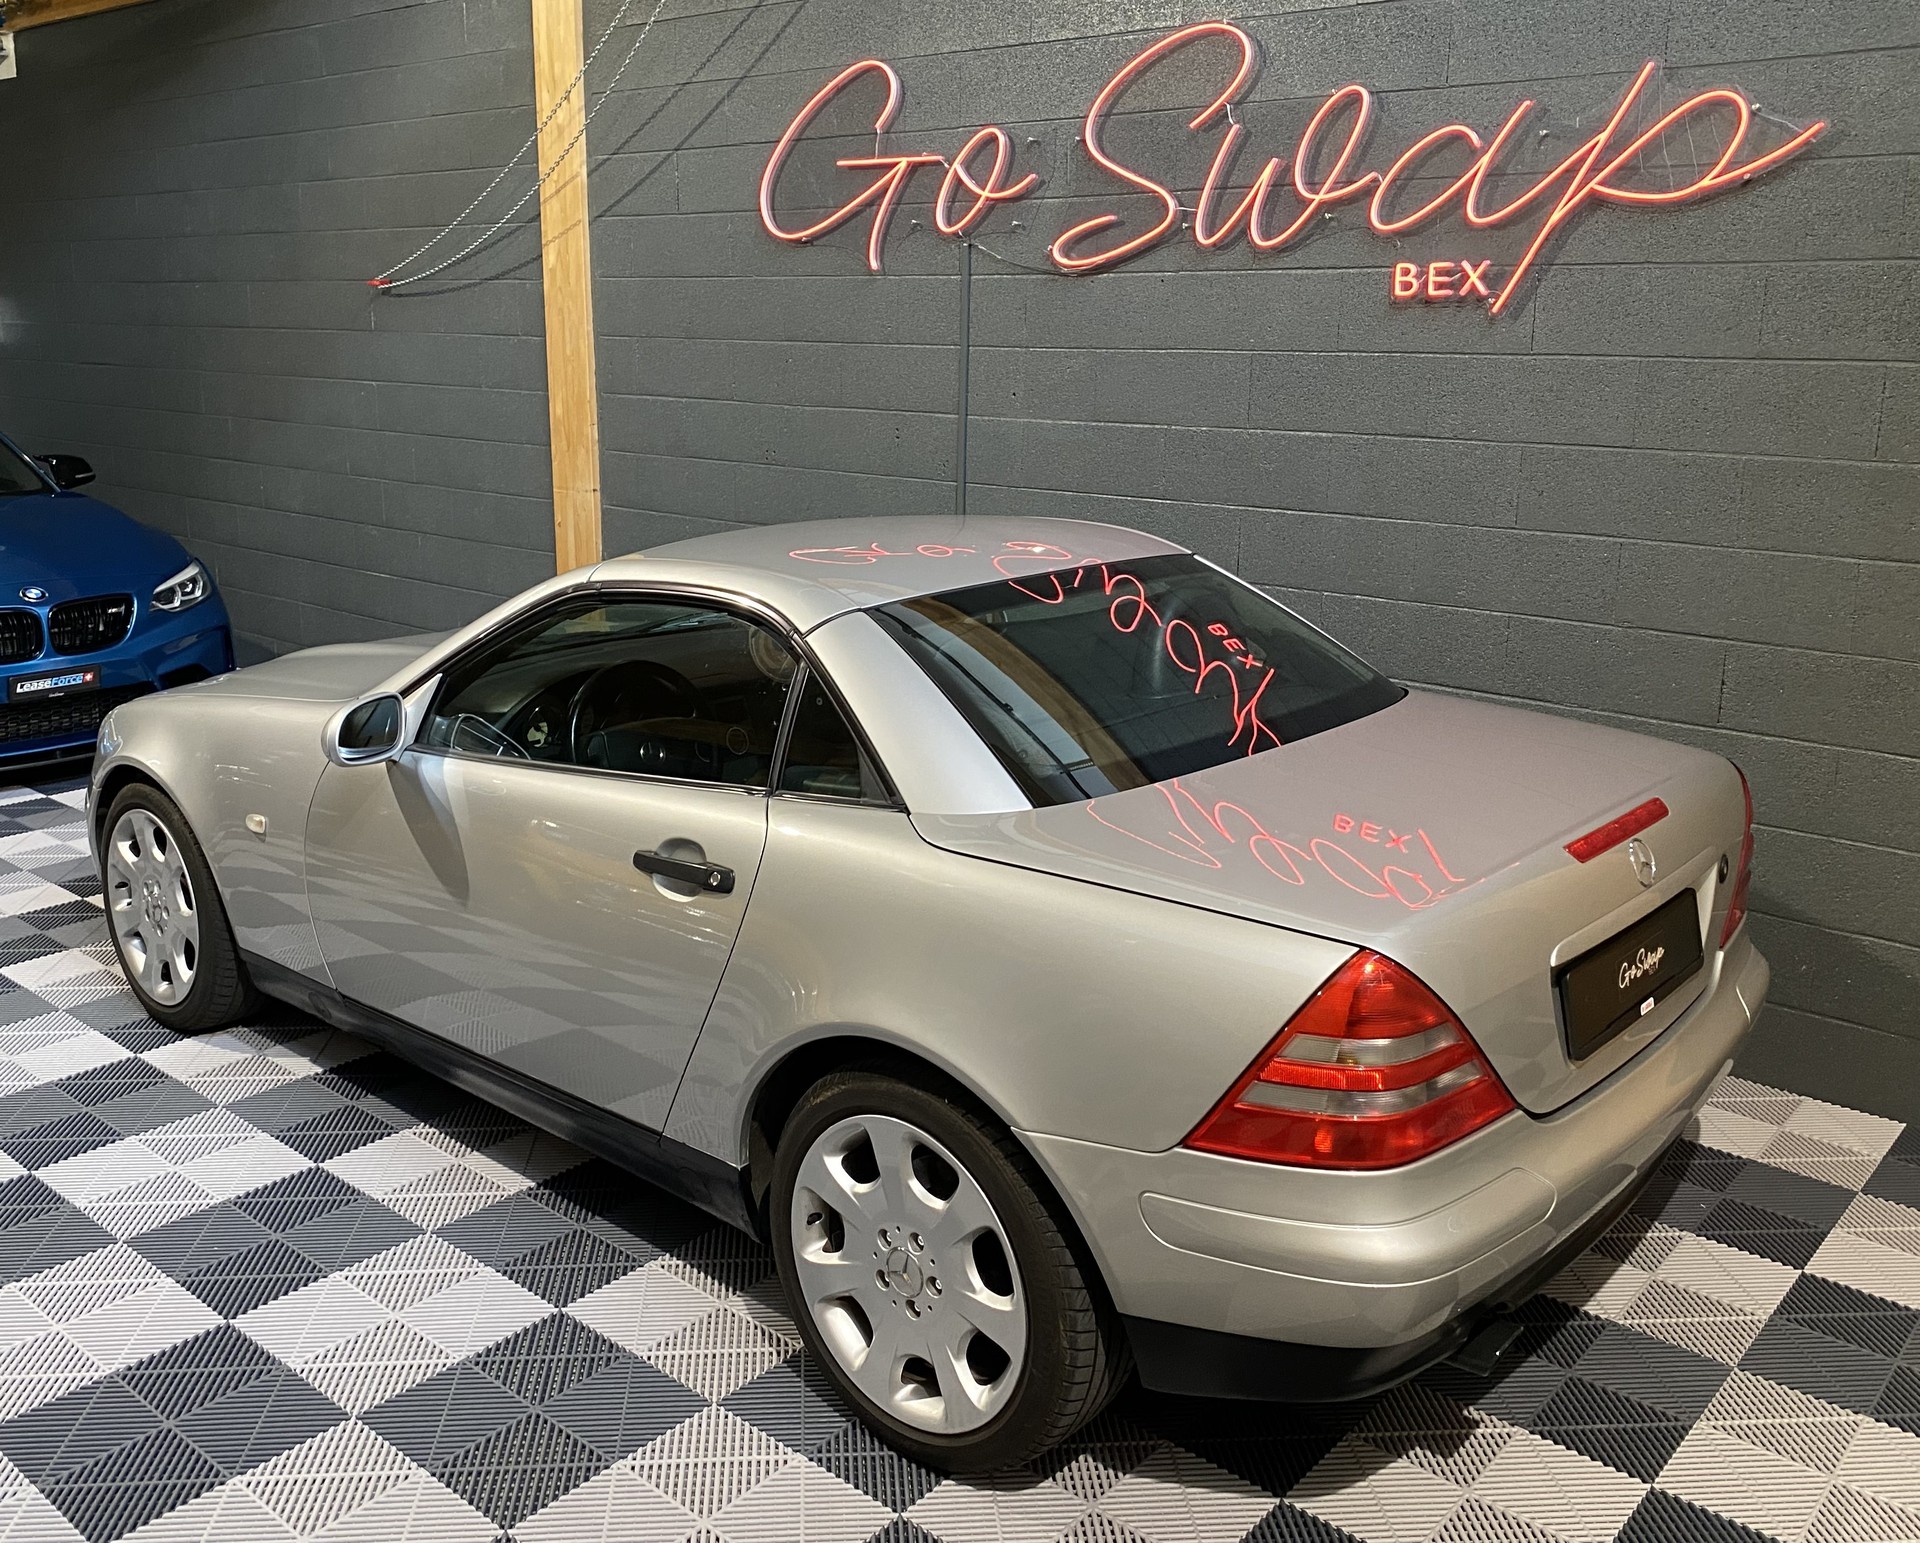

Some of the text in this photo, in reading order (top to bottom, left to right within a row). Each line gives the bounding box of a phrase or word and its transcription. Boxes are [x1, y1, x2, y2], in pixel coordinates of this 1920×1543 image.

[759, 20, 1827, 315] Go Swap
[1393, 259, 1493, 298] BEX
[15, 673, 83, 693] LeaseForce
